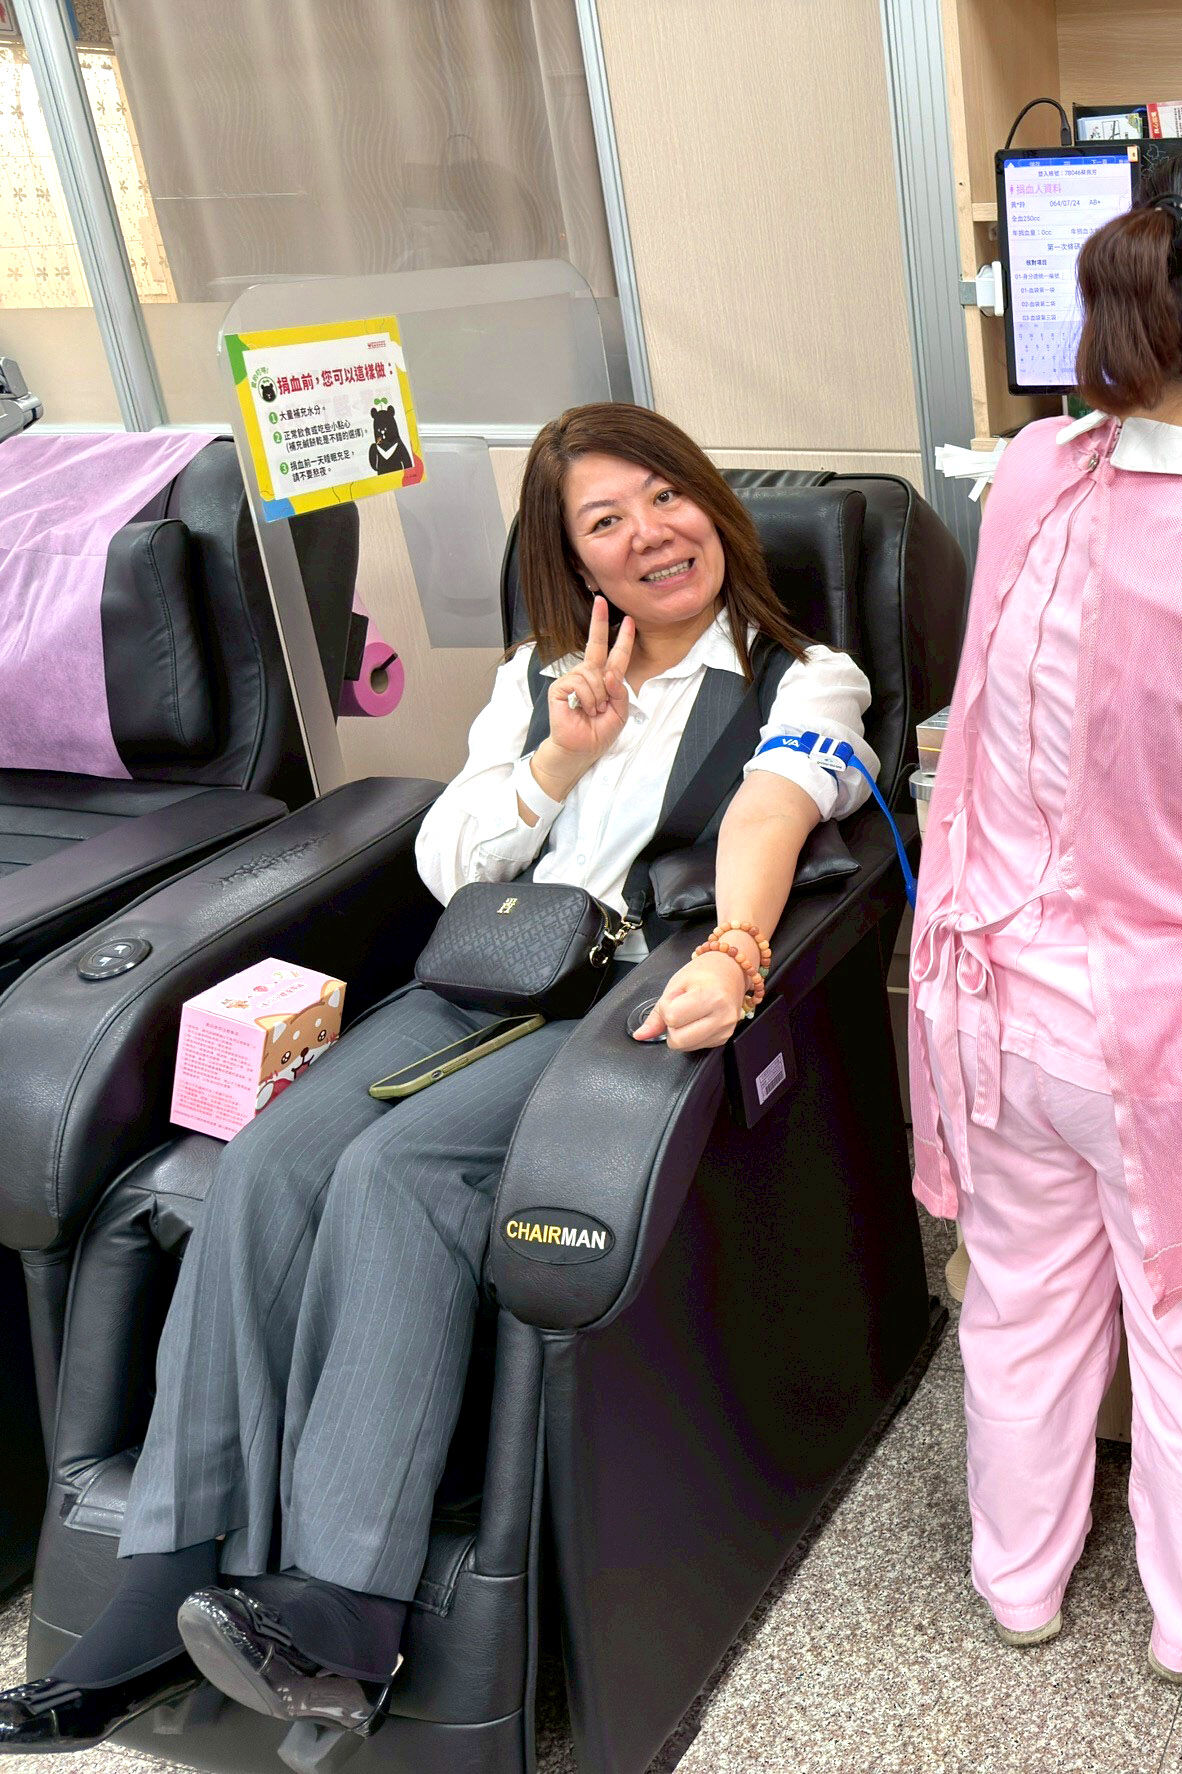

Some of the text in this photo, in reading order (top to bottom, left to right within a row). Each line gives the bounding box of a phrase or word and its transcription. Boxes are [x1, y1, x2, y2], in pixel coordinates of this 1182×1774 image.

[277, 362, 393, 396] 捐血前，您可以這樣做：
[279, 404, 326, 422] 大量補充水分。
[283, 419, 351, 441] 正常飲食或吃些小點心
[289, 449, 355, 472] 捐血前一天睡眠充足，
[506, 1220, 607, 1250] CHAIRMAN
